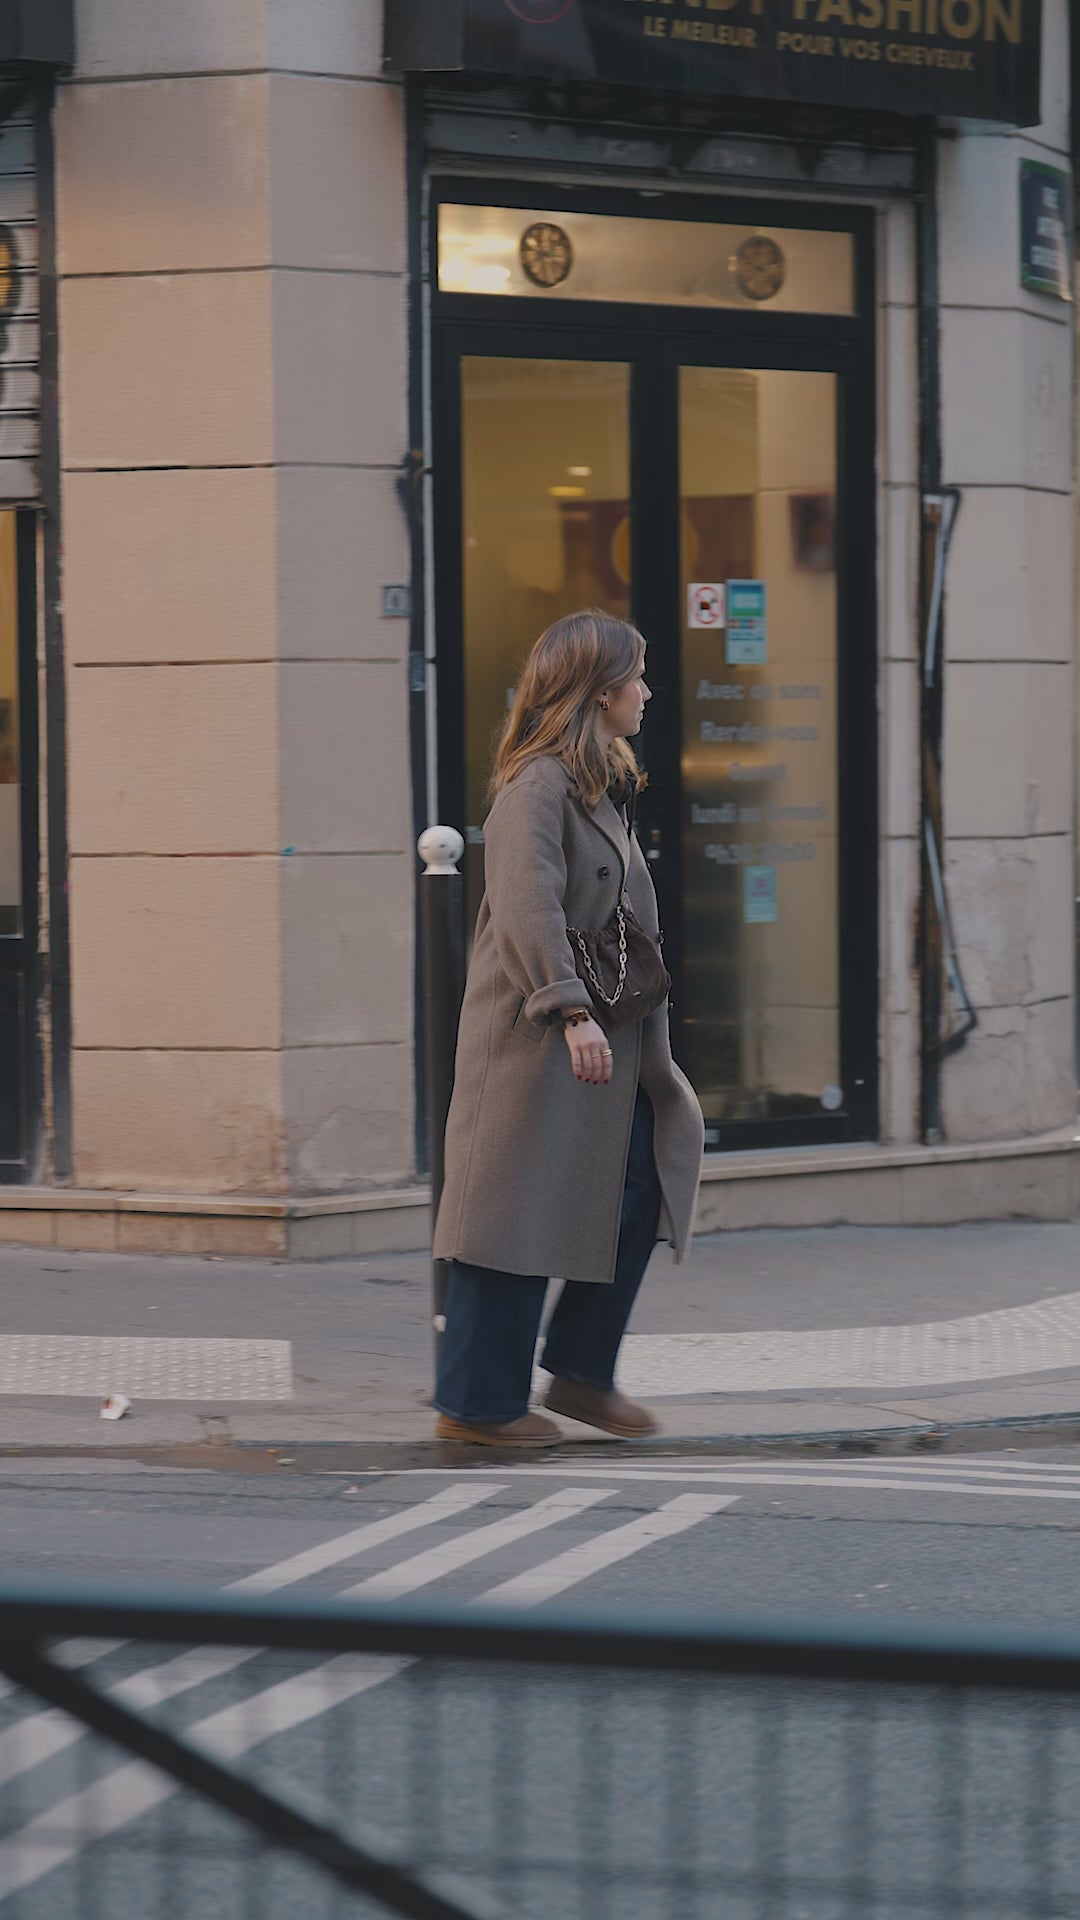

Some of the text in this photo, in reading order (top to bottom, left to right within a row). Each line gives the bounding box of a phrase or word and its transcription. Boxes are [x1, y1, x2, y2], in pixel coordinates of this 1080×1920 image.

[643, 15, 667, 38] LE
[777, 31, 975, 71] POUR VOS CHEVEUX
[697, 679, 744, 700] Avec
